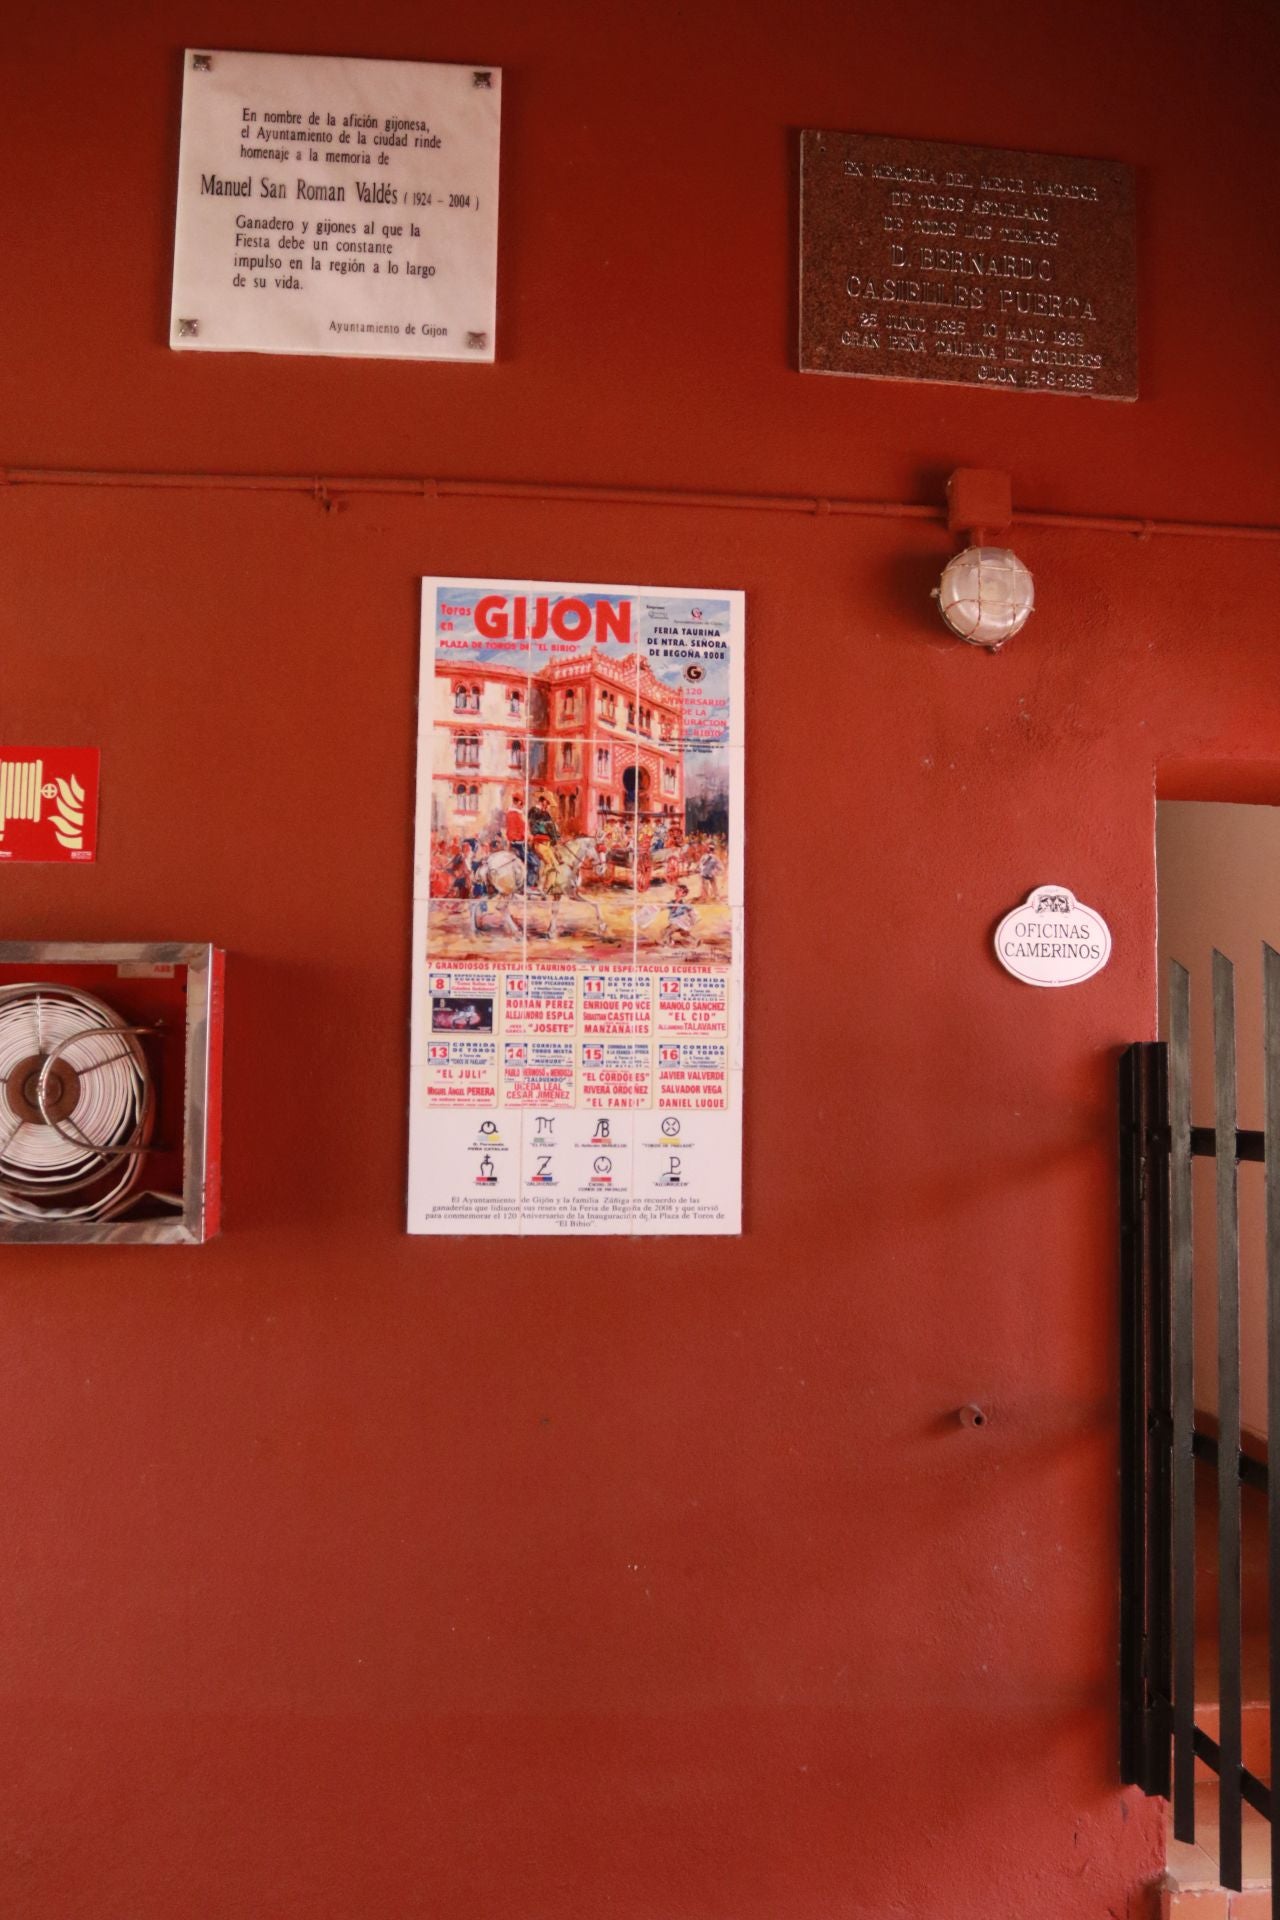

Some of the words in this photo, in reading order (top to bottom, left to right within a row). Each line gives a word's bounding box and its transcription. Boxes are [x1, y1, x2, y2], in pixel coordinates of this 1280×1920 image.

[243, 108, 257, 122] En
[264, 110, 302, 124] nombre
[309, 113, 320, 126] de
[327, 113, 336, 126] la
[343, 113, 378, 128] afición
[385, 115, 430, 133] gijonesa,
[241, 126, 249, 138] el
[258, 127, 333, 143] Ayuntamiento
[340, 131, 350, 144] de
[358, 131, 366, 144] la
[374, 132, 408, 146] ciudad
[415, 133, 442, 149] rinde
[241, 147, 289, 162] homenaje
[296, 150, 301, 161] a
[310, 149, 318, 161] la
[326, 150, 370, 164] memoria
[378, 152, 389, 165] de
[844, 161, 864, 177] EN
[872, 164, 936, 184] MEMORIA
[946, 172, 973, 188] DEL
[980, 175, 1025, 194] MEJOR
[1033, 180, 1099, 201] MATADOR
[201, 174, 251, 198] Manuel
[261, 177, 286, 199] San
[297, 180, 345, 202] Roman
[357, 182, 398, 205] Valdés
[413, 193, 431, 206] 1924
[449, 194, 471, 208] 2004
[892, 192, 911, 206] DE
[919, 195, 964, 212] TOROS
[972, 200, 1048, 222] ASTURIANO
[236, 215, 294, 232] Ganadero
[302, 220, 308, 234] y
[317, 218, 356, 236] gijones
[364, 221, 374, 235] al
[382, 223, 403, 239] que
[411, 223, 420, 237] la
[884, 216, 903, 231] DE
[913, 218, 956, 236] TODOS
[965, 224, 992, 240] LOS
[1000, 228, 1059, 246] TIEMPOS
[236, 234, 270, 248] Fiesta
[279, 236, 305, 250] debe
[314, 240, 328, 251] un
[336, 240, 393, 254] constante
[234, 254, 282, 271] impulso
[290, 258, 303, 270] en
[312, 257, 321, 271] la
[330, 259, 365, 275] región
[373, 264, 379, 274] a
[388, 261, 399, 274] lo
[406, 262, 435, 278] largo
[891, 244, 911, 267] D.
[920, 248, 1053, 282] BERNARDO
[233, 274, 246, 288] de
[254, 278, 266, 288] su
[275, 277, 303, 290] vida.
[847, 275, 984, 309] CASIELLES
[1000, 289, 1097, 321] PUERTA
[329, 320, 399, 335] Ayuntamiento
[406, 323, 416, 336] de
[422, 325, 447, 338] Gijon
[886, 315, 926, 333] JUNIO
[983, 323, 996, 338] 10
[1006, 326, 1046, 346] MAYO
[841, 332, 880, 349] GRAN
[889, 334, 927, 352] PEÑA
[936, 340, 997, 359] TAURINA
[1005, 347, 1023, 362] EL
[978, 366, 1016, 383] GIJON
[440, 604, 471, 616] Toros
[474, 595, 631, 644] GIJON
[440, 621, 453, 631] en
[655, 627, 678, 635] FERIA
[682, 628, 720, 637] TAURINA
[440, 640, 468, 648] PLAZA
[486, 642, 516, 650] TOROS
[691, 638, 727, 648] SEÑORA
[664, 649, 700, 658] BEGOÑA
[704, 651, 724, 659] 2008
[1016, 923, 1090, 939] OFICINAS
[1005, 942, 1100, 959] CAMERINOS
[436, 962, 489, 970] GRANDIOSOS
[436, 979, 445, 989] 8
[586, 982, 601, 991] 11
[663, 983, 679, 992] 12
[506, 1000, 541, 1008] ROMAN
[546, 1000, 574, 1008] PEREZ
[583, 1001, 619, 1009] ENRIQUE
[660, 1002, 690, 1010] MANOLO
[693, 1002, 725, 1010] SANCHEZ
[669, 1013, 686, 1021] "EL
[692, 1013, 716, 1021] CID"
[528, 1024, 573, 1033] "JOSETE"
[431, 1047, 447, 1058] 13
[585, 1049, 602, 1059] 15
[662, 1050, 678, 1060] 16
[437, 1070, 452, 1078] "EL
[459, 1070, 486, 1078] JULI"
[583, 1073, 596, 1081] "EL
[659, 1071, 684, 1080] JAVIER
[688, 1072, 724, 1080] VALVERDE
[584, 1085, 610, 1094] RIVERA
[661, 1085, 700, 1094] SALVADOR
[703, 1085, 722, 1094] VEGA
[659, 1099, 692, 1107] DANIEL
[695, 1099, 724, 1107] LUQUE
[533, 1196, 553, 1204] Gijón
